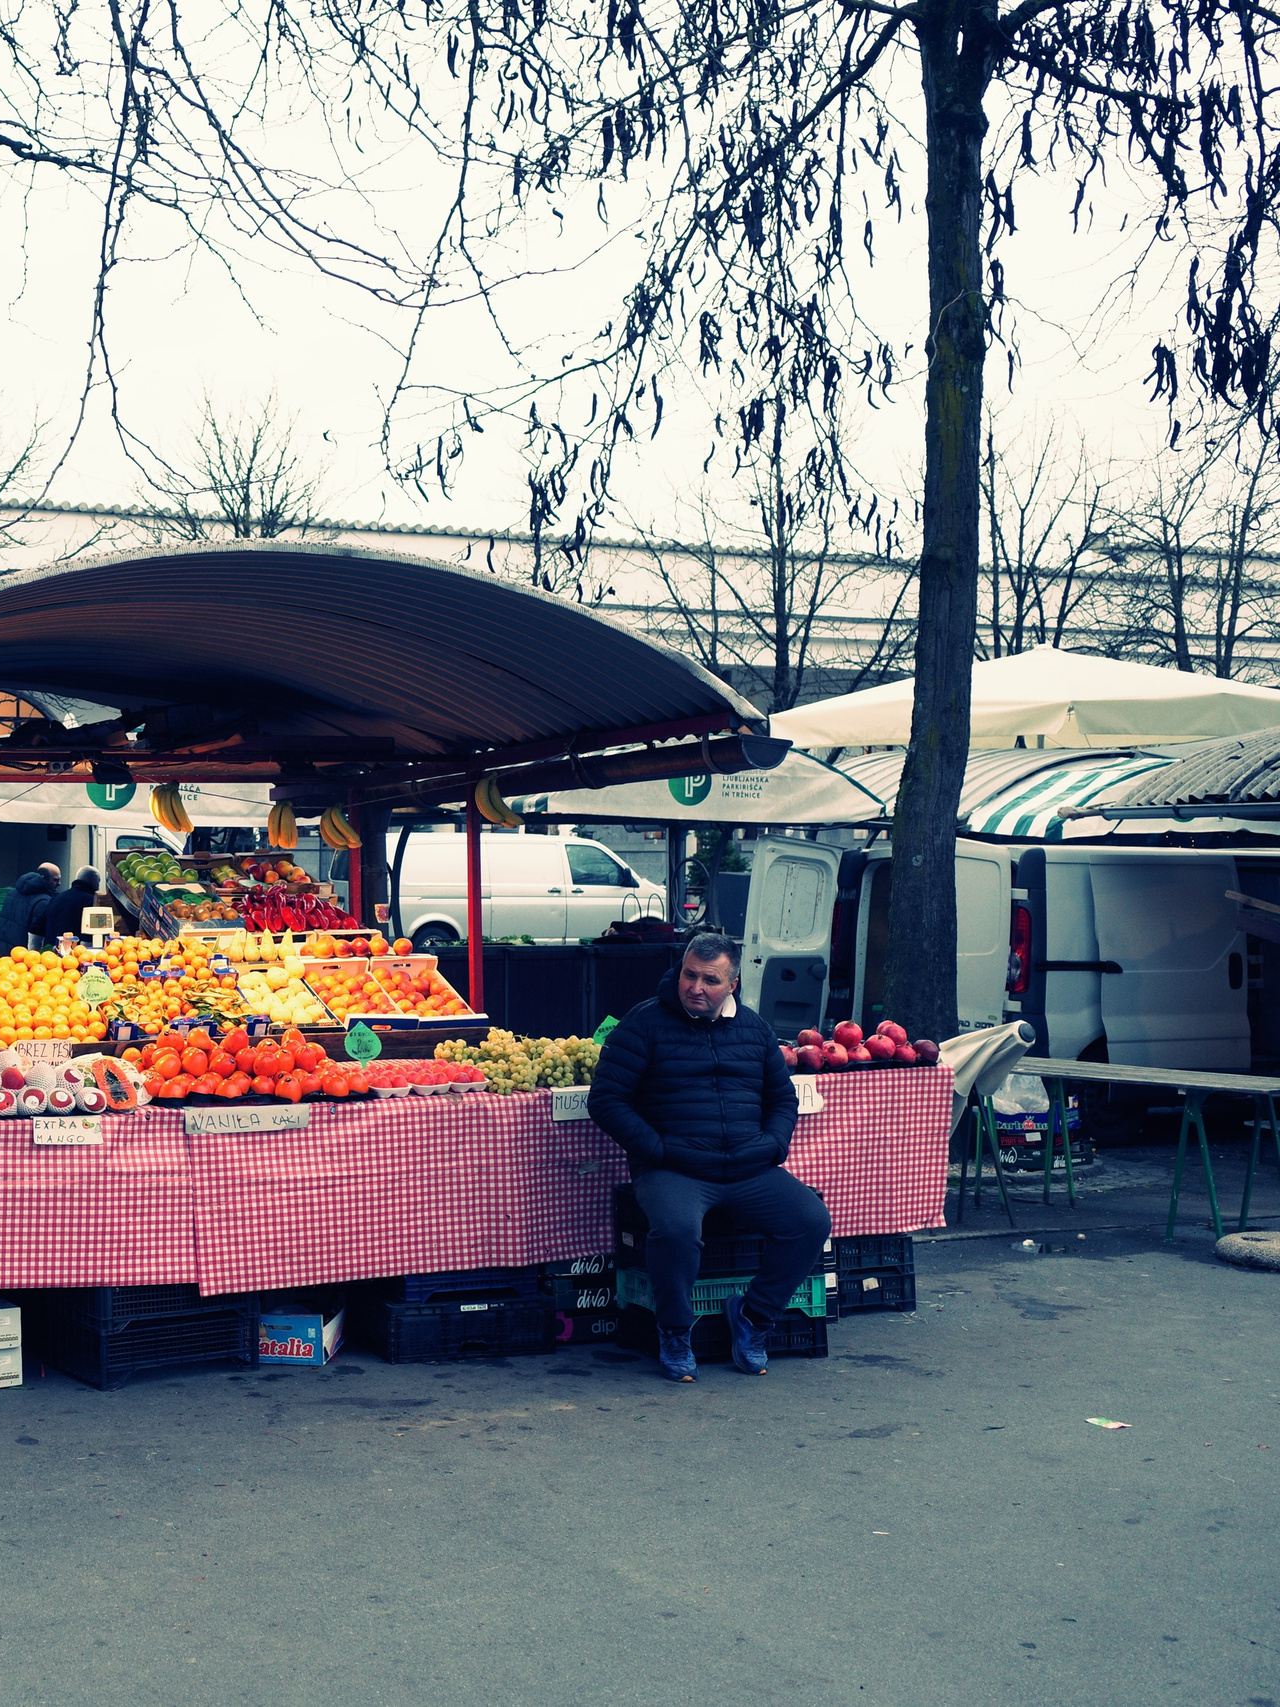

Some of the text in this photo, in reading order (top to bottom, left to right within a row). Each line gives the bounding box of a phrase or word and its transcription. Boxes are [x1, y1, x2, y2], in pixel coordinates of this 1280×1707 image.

[722, 783, 762, 791] PARKIRIŠČA
[18, 1042, 47, 1058] BREZ
[555, 1093, 588, 1110] MUŠK
[34, 1118, 78, 1130] EXTRA
[36, 1134, 85, 1143] MANGO
[258, 1337, 314, 1358] atalia
